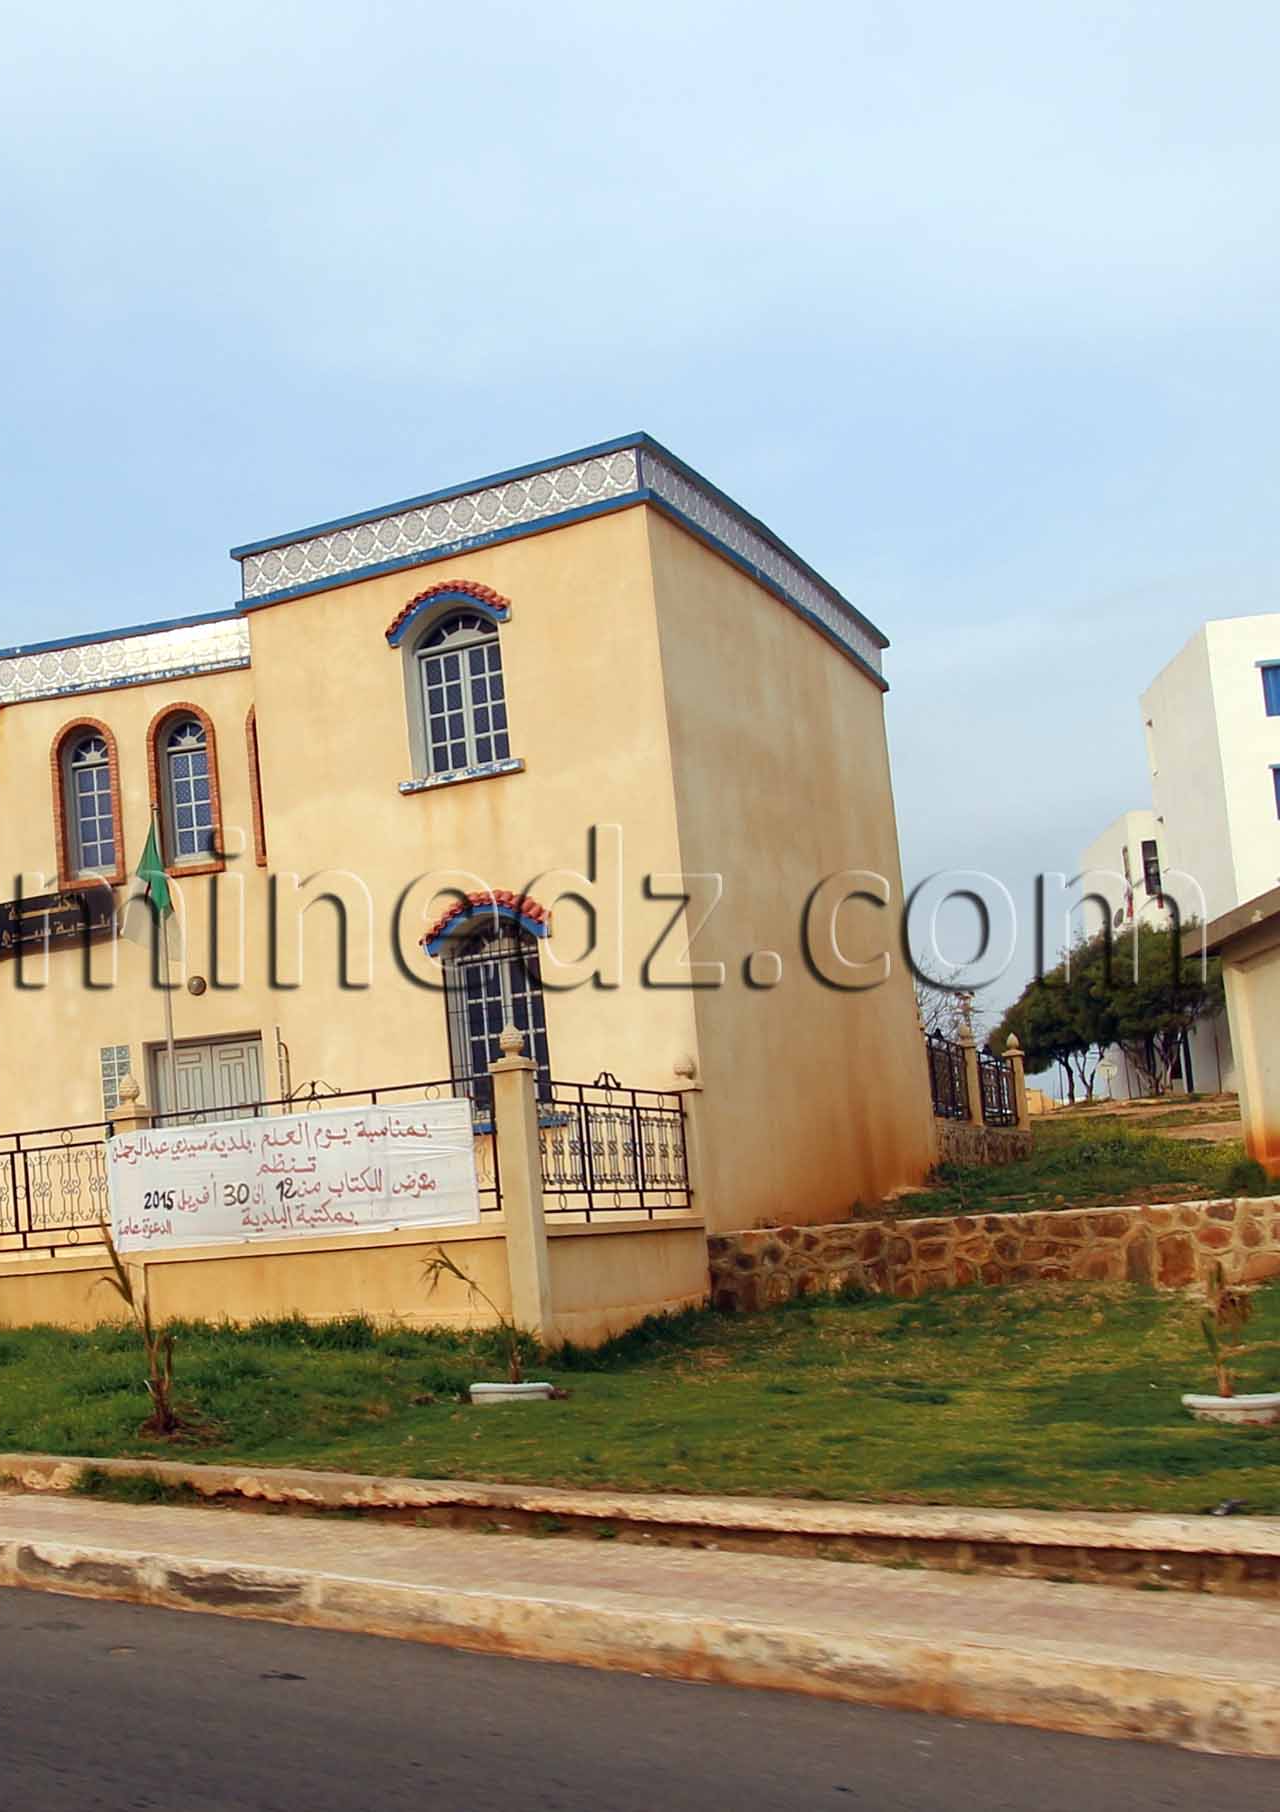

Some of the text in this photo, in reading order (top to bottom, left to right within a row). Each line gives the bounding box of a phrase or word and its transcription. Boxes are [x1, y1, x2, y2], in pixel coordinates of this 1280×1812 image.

[261, 1121, 311, 1161] العلم
[314, 1127, 352, 1151] يوم
[353, 1115, 433, 1143] بمناسبة
[170, 1136, 209, 1161] سيدي
[256, 1153, 317, 1177] تنظم
[276, 1176, 297, 1203] 12
[295, 1180, 322, 1198] من
[327, 1166, 383, 1198] للكتاب
[392, 1172, 438, 1199] معرض
[143, 1190, 177, 1211] 2015
[223, 1183, 250, 1207] 30
[117, 1216, 173, 1239] الدعوة عامة
[241, 1199, 360, 1232] بمكتبة البلدية
